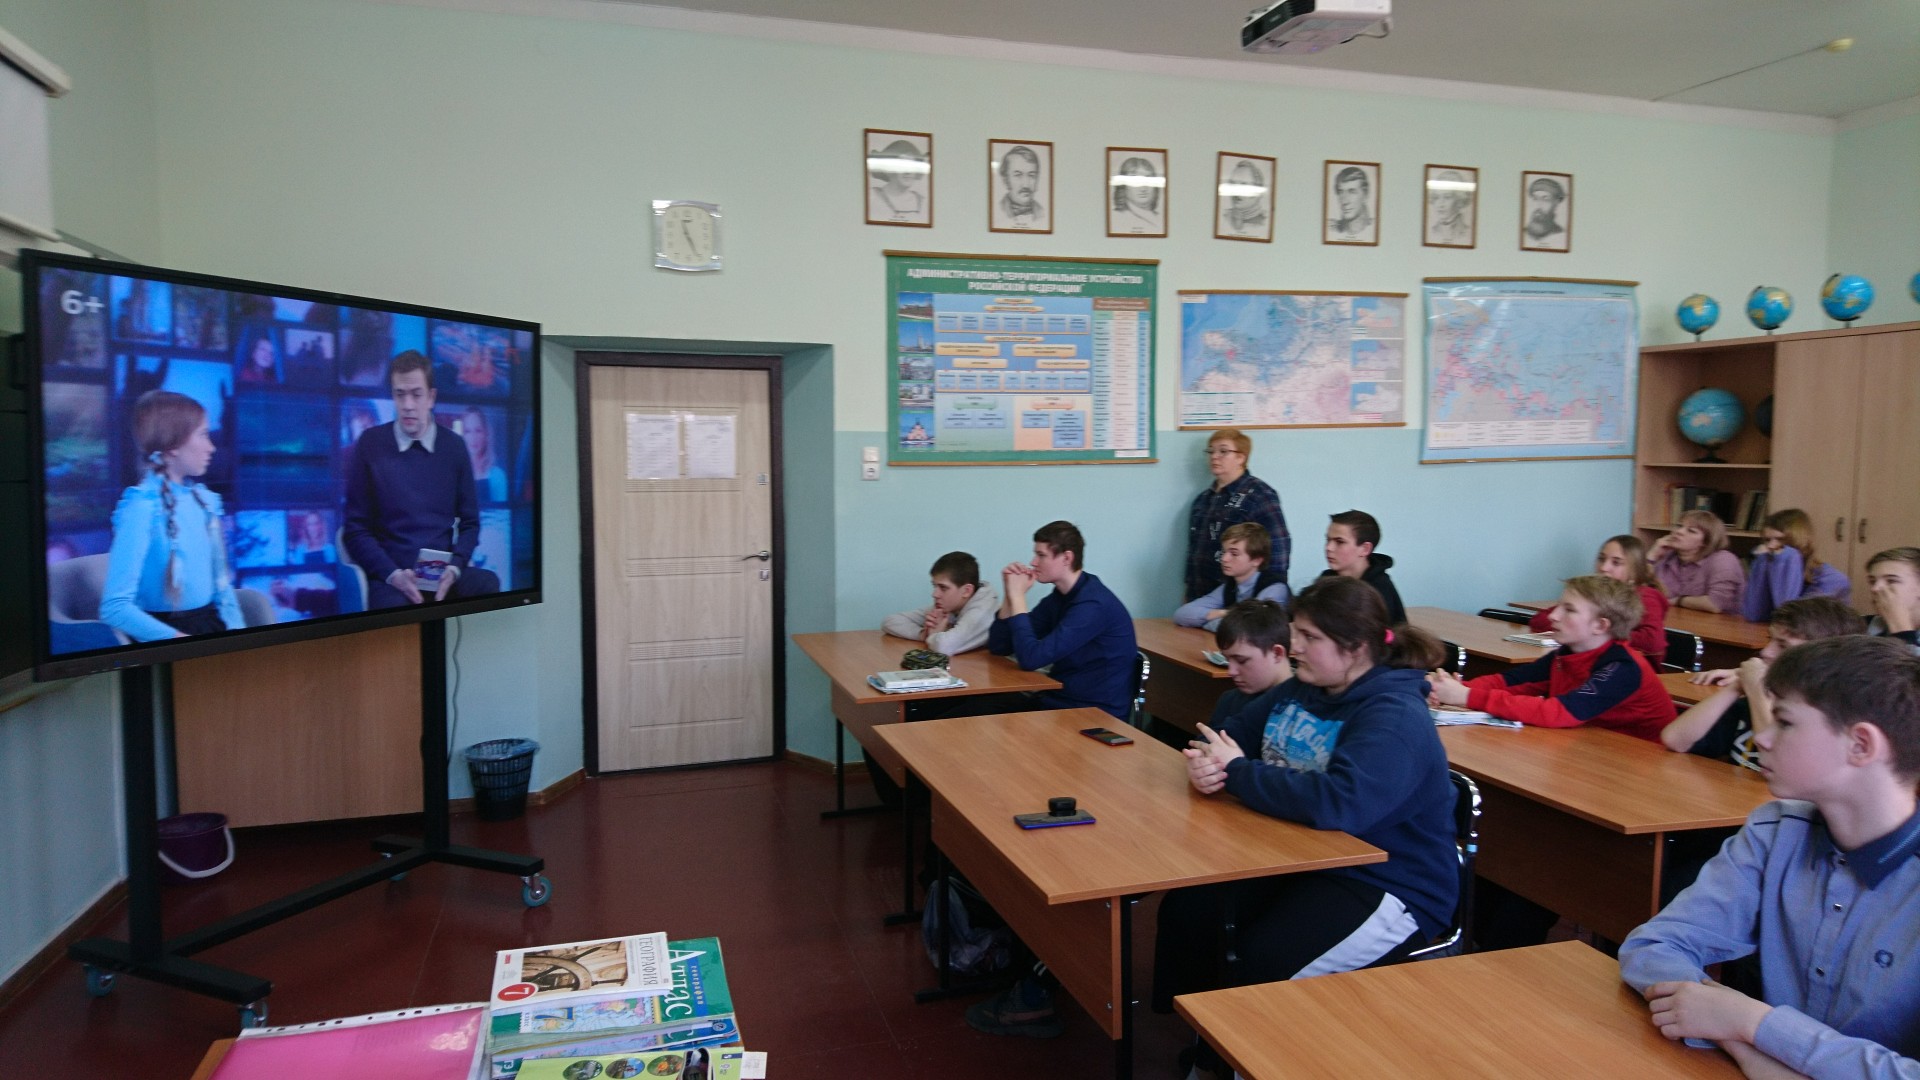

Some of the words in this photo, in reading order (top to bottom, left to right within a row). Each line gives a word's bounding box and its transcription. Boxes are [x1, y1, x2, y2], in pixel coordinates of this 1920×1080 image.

[61, 290, 105, 315] 6+
[639, 936, 658, 986] ГЕОГРАФИЯ
[504, 987, 529, 996] 7
[664, 949, 707, 1018] Атлас
[690, 965, 704, 1005] география
[533, 1007, 574, 1021] 7
